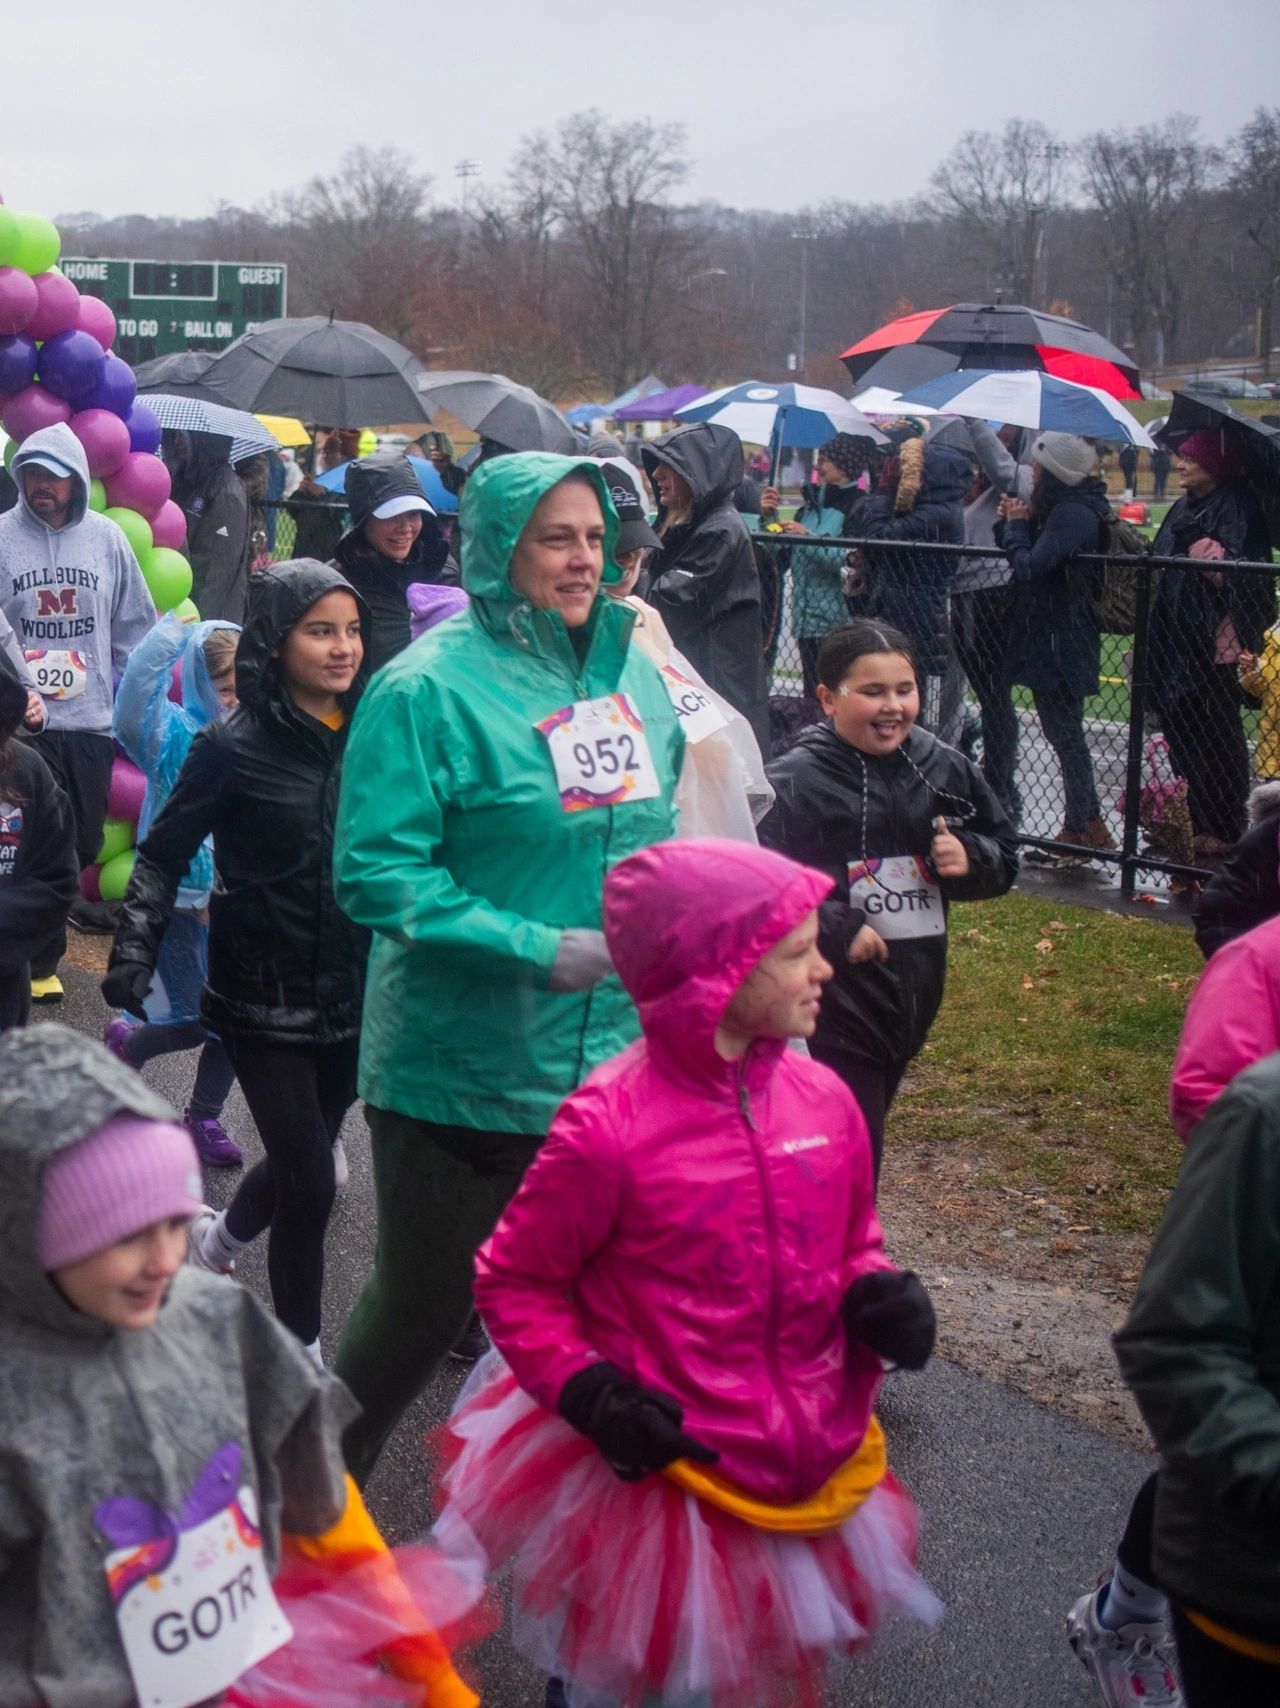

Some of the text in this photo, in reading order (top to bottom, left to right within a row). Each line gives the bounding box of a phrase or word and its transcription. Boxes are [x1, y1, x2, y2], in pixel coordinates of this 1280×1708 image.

[64, 263, 108, 280] HOME
[238, 267, 282, 285] GUEST
[119, 319, 158, 337] TO GO
[184, 321, 214, 338] BALL
[215, 321, 232, 338] ON
[12, 567, 99, 596] MILLBURY
[37, 588, 77, 617] M
[21, 616, 95, 639] WOOLIES
[37, 668, 73, 687] 920
[573, 734, 641, 779] 952
[864, 889, 932, 915] GOTR
[152, 1565, 256, 1655] GOTR
